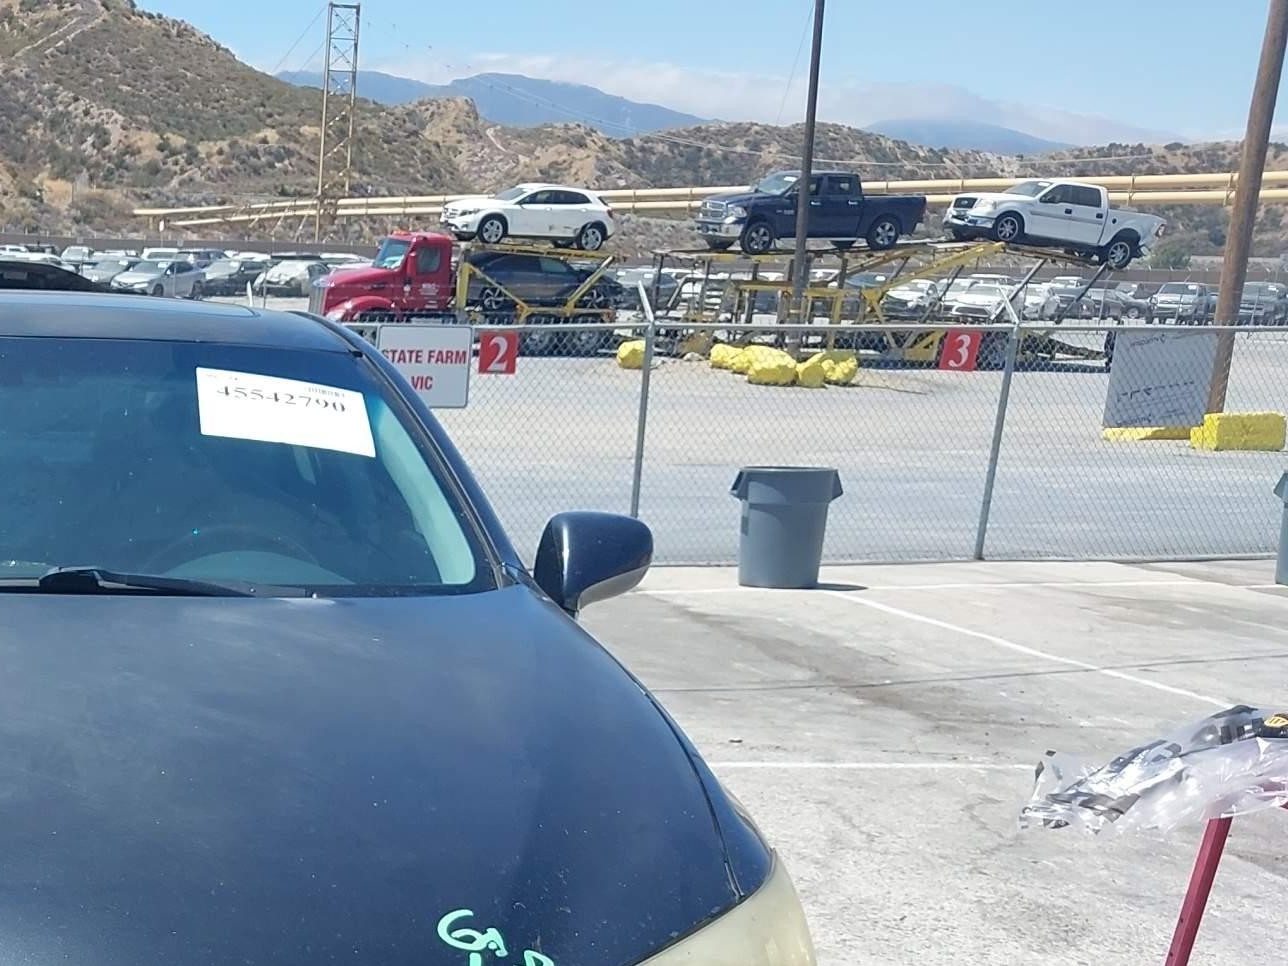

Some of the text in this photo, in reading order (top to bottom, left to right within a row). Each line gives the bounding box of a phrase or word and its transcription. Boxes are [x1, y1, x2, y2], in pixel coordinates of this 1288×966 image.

[382, 349, 467, 364] STATE FARM
[487, 336, 508, 372] 2
[948, 334, 971, 367] 3
[411, 375, 433, 390] VIC
[216, 386, 346, 412] 45542790
